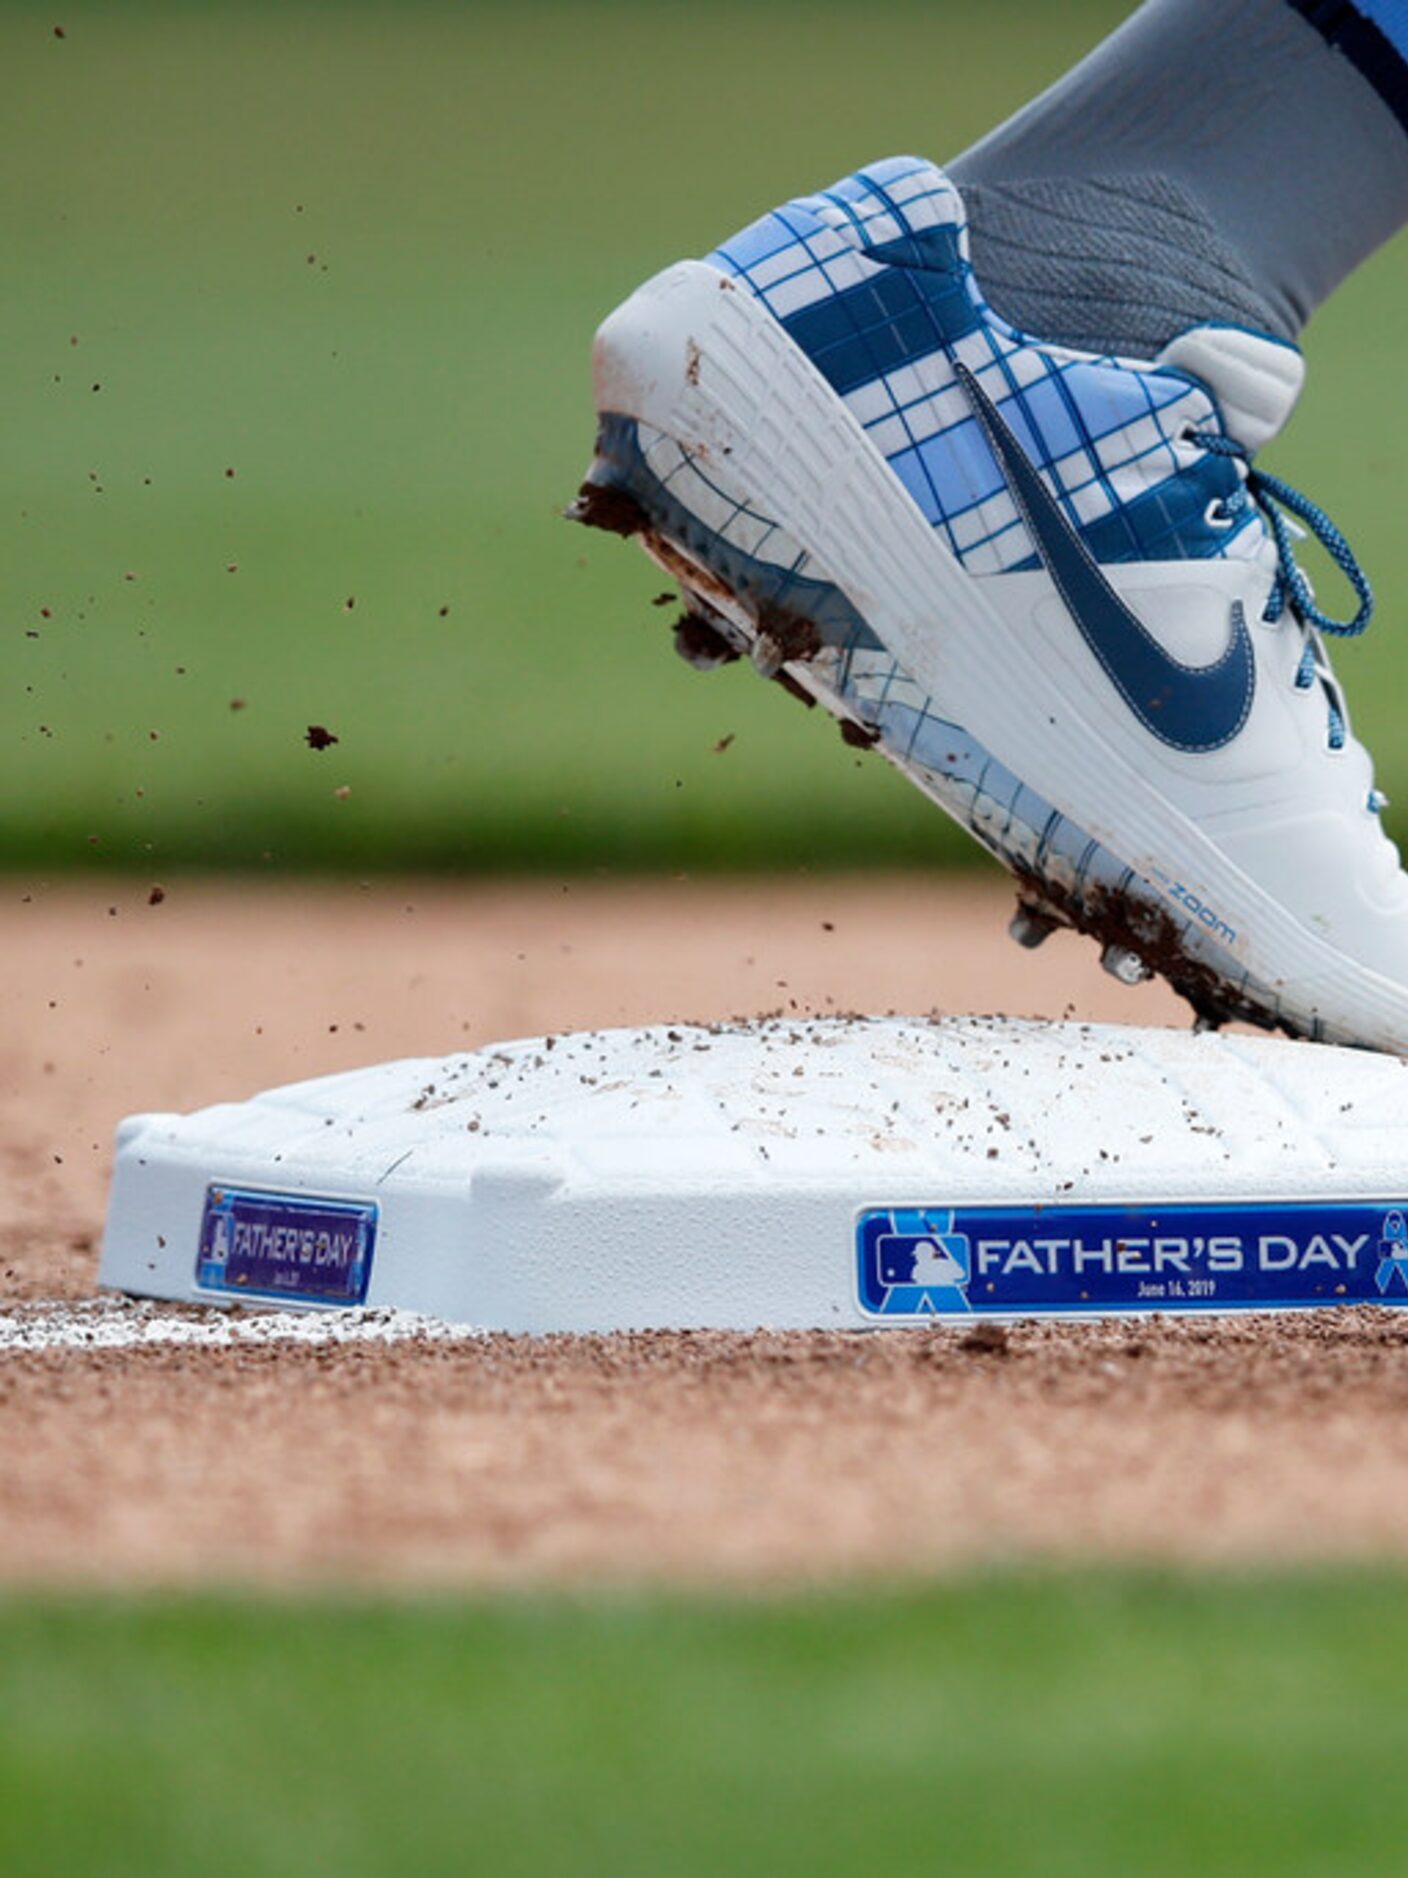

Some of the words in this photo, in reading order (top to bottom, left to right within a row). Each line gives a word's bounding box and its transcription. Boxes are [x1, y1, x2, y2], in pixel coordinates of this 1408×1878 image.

[230, 1221, 315, 1263] FATHER'S
[315, 1230, 354, 1268] DAY
[977, 1236, 1244, 1275] FATHER'S
[1258, 1233, 1370, 1272] DAY
[1137, 1280, 1166, 1298] June
[1168, 1280, 1187, 1297] 16,
[1188, 1279, 1217, 1297] 2019
